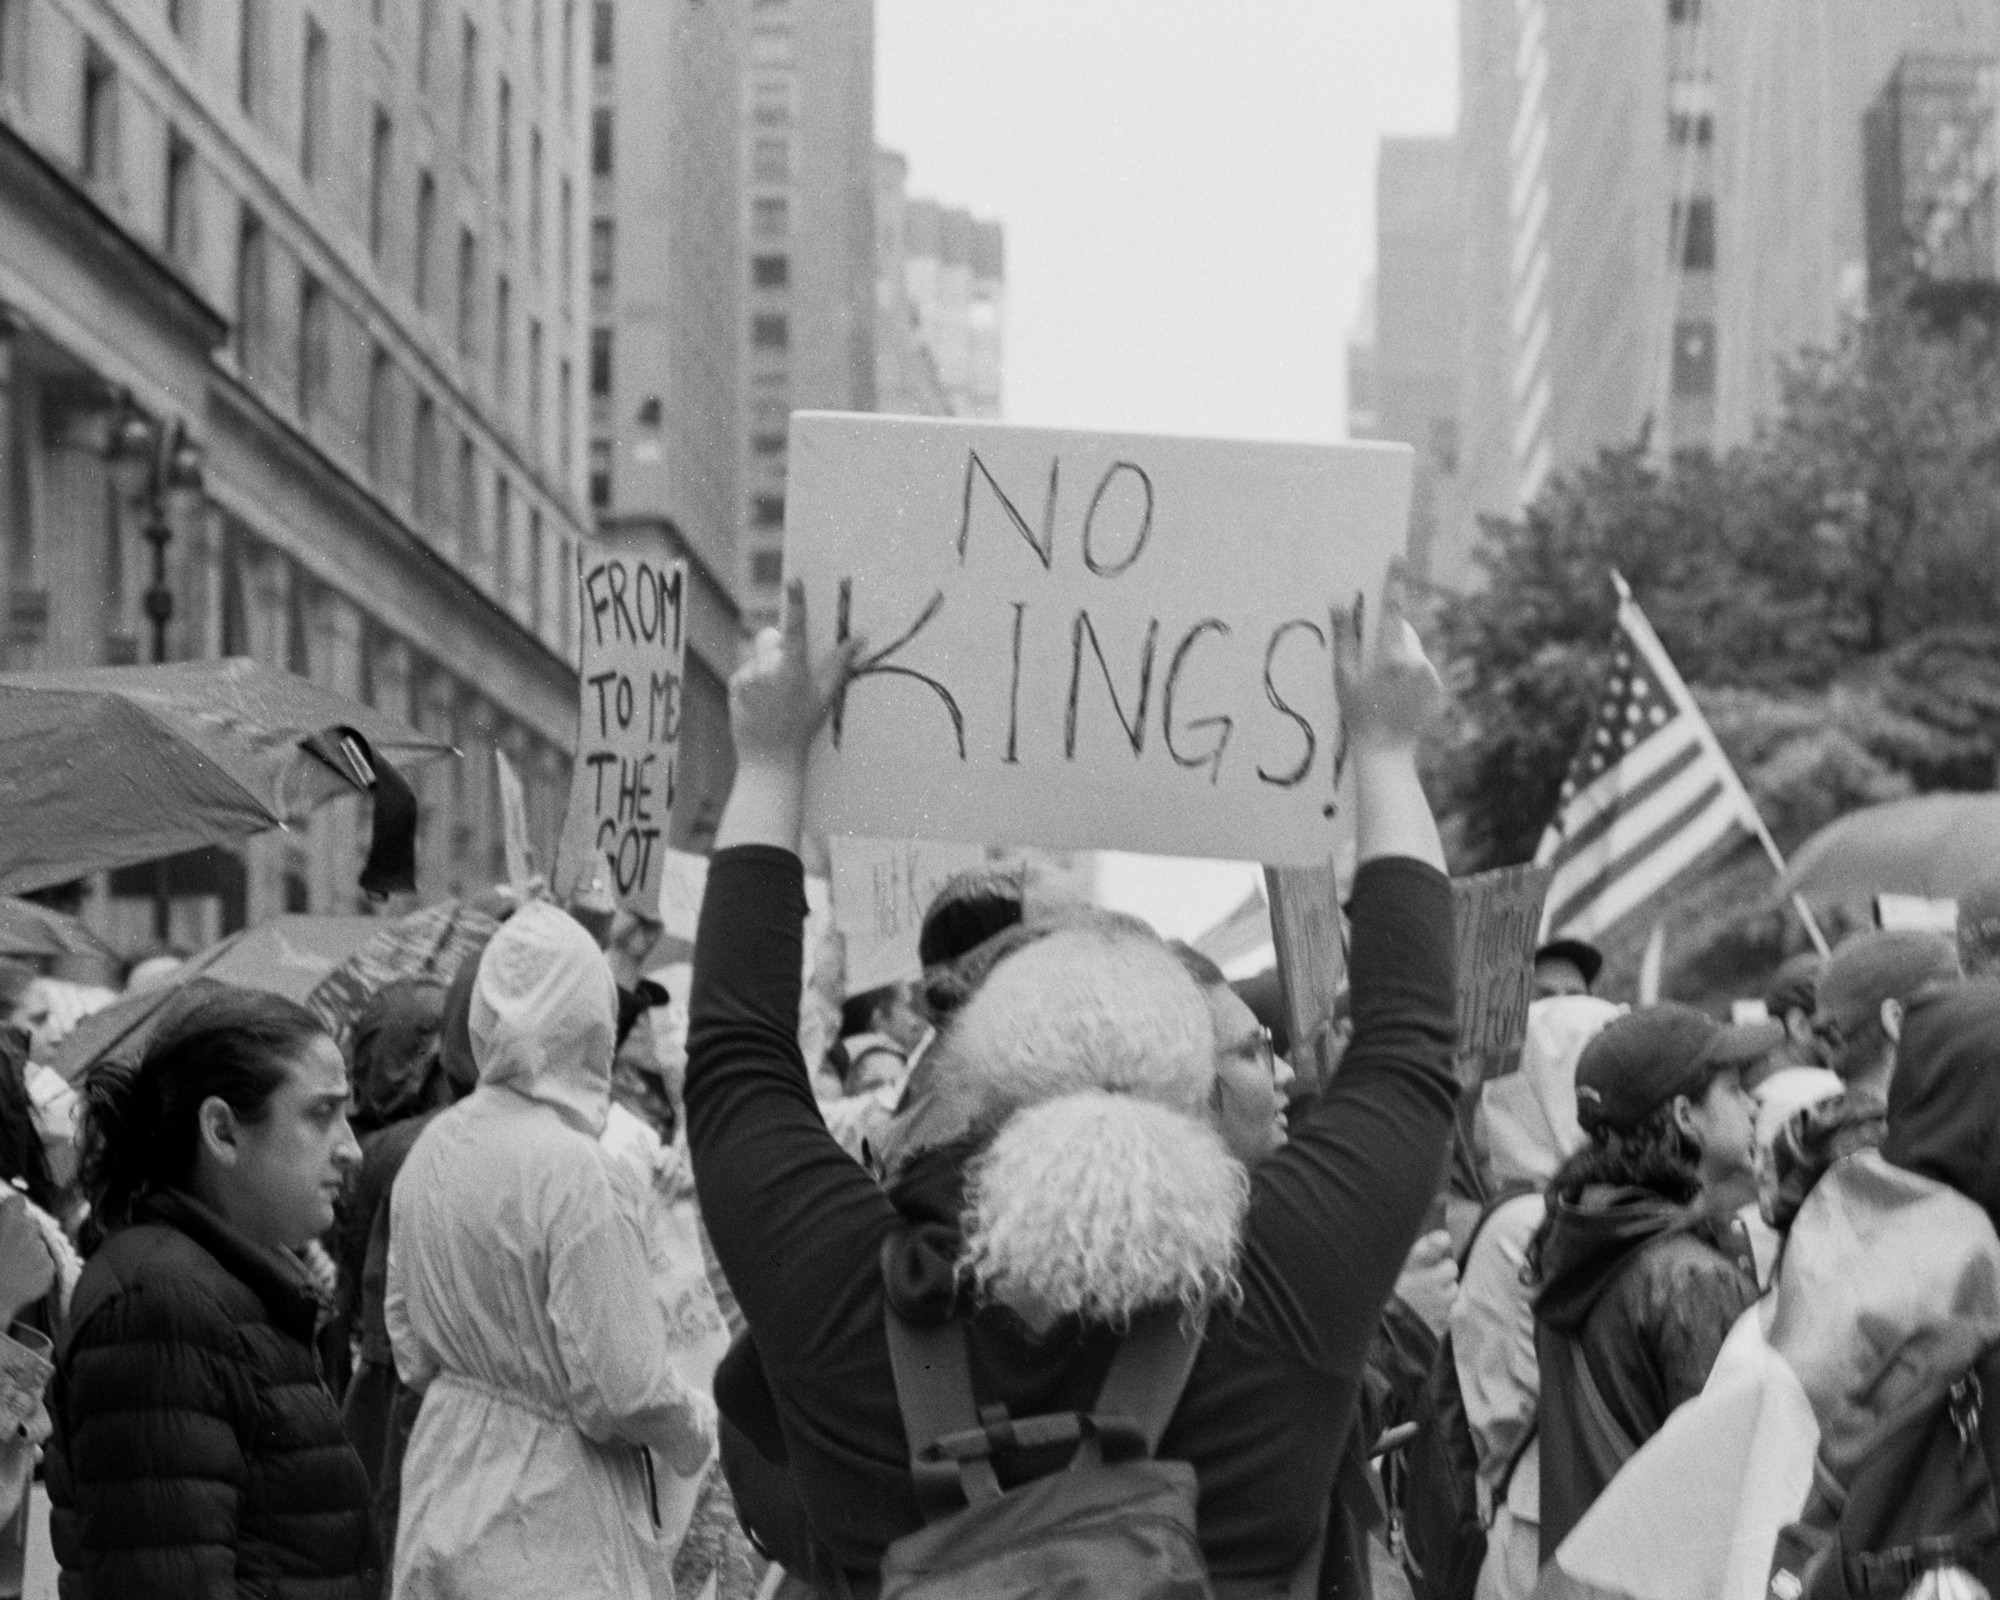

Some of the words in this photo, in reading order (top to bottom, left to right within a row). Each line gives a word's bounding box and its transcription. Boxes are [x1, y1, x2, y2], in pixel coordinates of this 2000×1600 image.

[957, 448, 1154, 578] NO
[586, 560, 683, 650] FROM
[587, 671, 634, 739] TO
[832, 576, 1365, 818] KINGS!
[586, 752, 653, 823] THE
